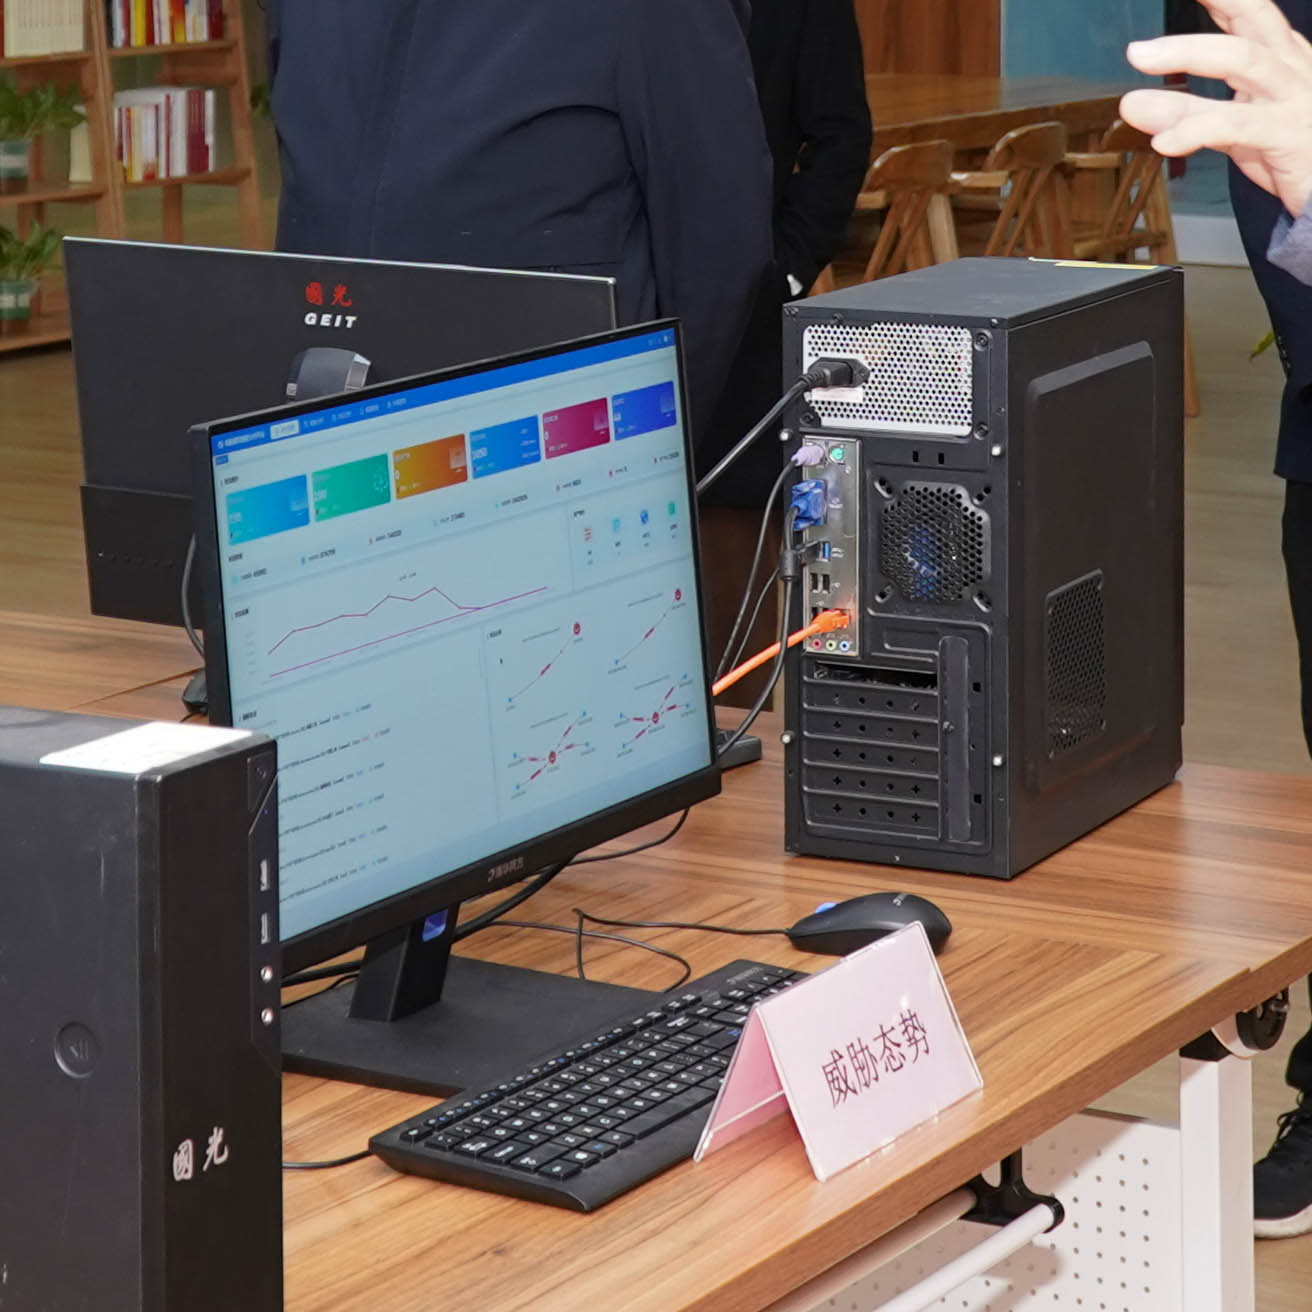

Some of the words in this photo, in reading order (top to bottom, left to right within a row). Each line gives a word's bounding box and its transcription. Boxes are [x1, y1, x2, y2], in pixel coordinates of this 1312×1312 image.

[304, 312, 357, 328] GEIT
[820, 1008, 931, 1109] 威胁态势
